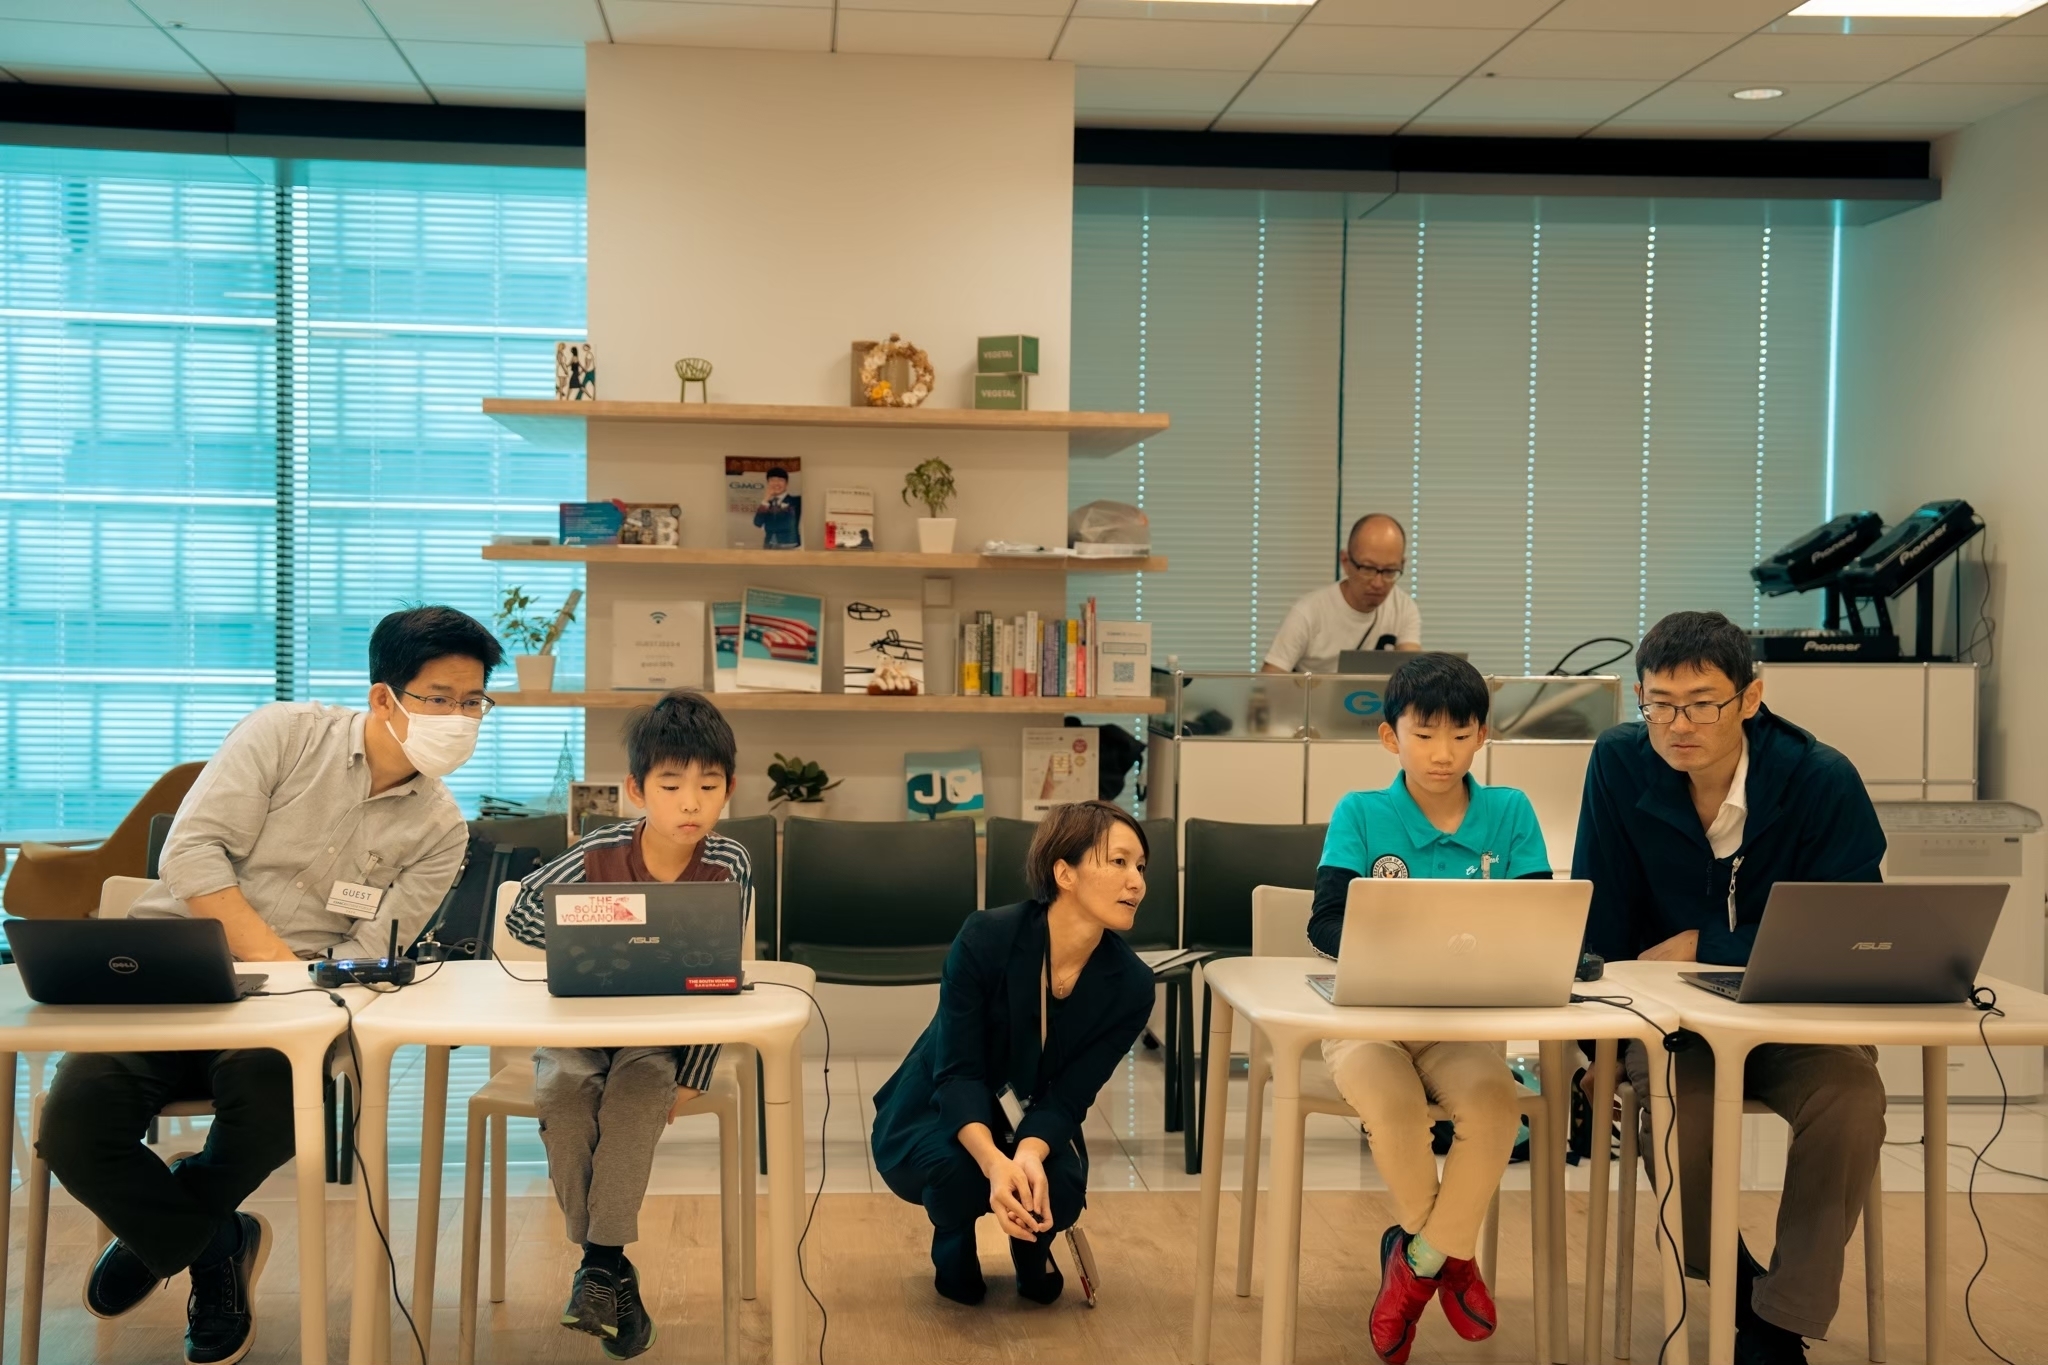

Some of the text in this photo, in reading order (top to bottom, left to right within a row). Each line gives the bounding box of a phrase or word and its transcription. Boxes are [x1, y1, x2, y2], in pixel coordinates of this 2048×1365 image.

[983, 350, 1014, 359] VEGETAL
[981, 389, 1016, 398] VEGETAL
[729, 481, 764, 490] GMO
[1811, 530, 1857, 564] Pioneer
[1900, 523, 1947, 566] Pioneer
[1803, 641, 1861, 652] Pioneer
[1344, 690, 1385, 716] G
[342, 888, 372, 901] GUEST
[589, 896, 612, 905] THE
[575, 905, 613, 913] SOUTH
[561, 914, 613, 923] VOLCANO
[628, 936, 660, 944] ASUS
[1851, 942, 1893, 950] ASUS
